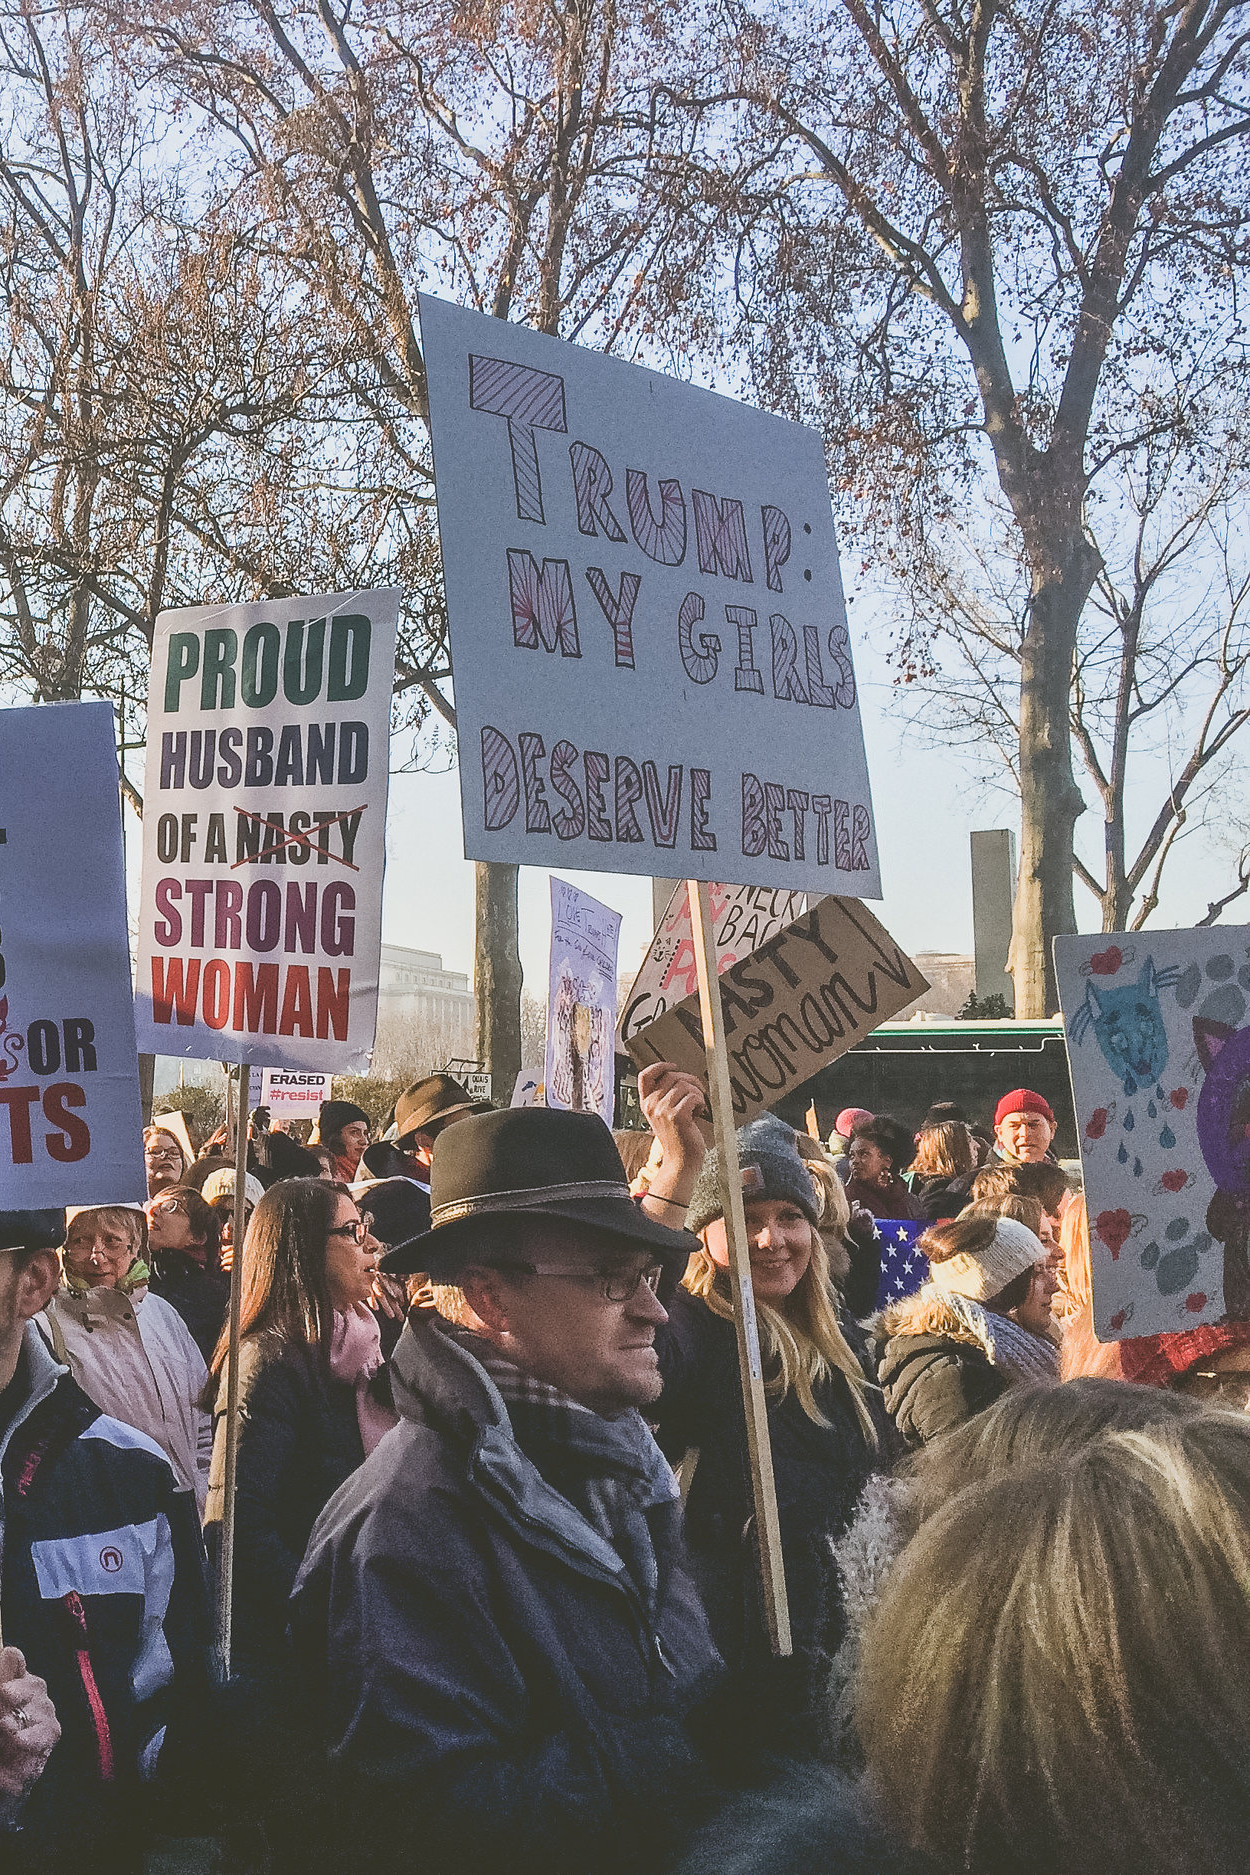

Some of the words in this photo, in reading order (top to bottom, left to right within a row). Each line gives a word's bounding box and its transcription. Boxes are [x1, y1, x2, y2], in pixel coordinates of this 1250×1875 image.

[468, 353, 812, 593] TRUMP:
[163, 614, 372, 713] PROUD
[506, 548, 642, 670] MY
[678, 591, 857, 709] GIRLS
[159, 721, 368, 790] HUSBAND
[480, 725, 717, 851] DESERVE
[741, 772, 871, 872] BETTER
[157, 812, 198, 864] OF
[204, 812, 227, 863] A
[236, 811, 363, 866] NASTY
[153, 878, 356, 957] STRONG
[717, 904, 784, 950] BAC
[151, 956, 352, 1042] WOMAN
[27, 1018, 98, 1076] OR
[270, 1074, 325, 1086] ERASED
[270, 1089, 323, 1101] #resist
